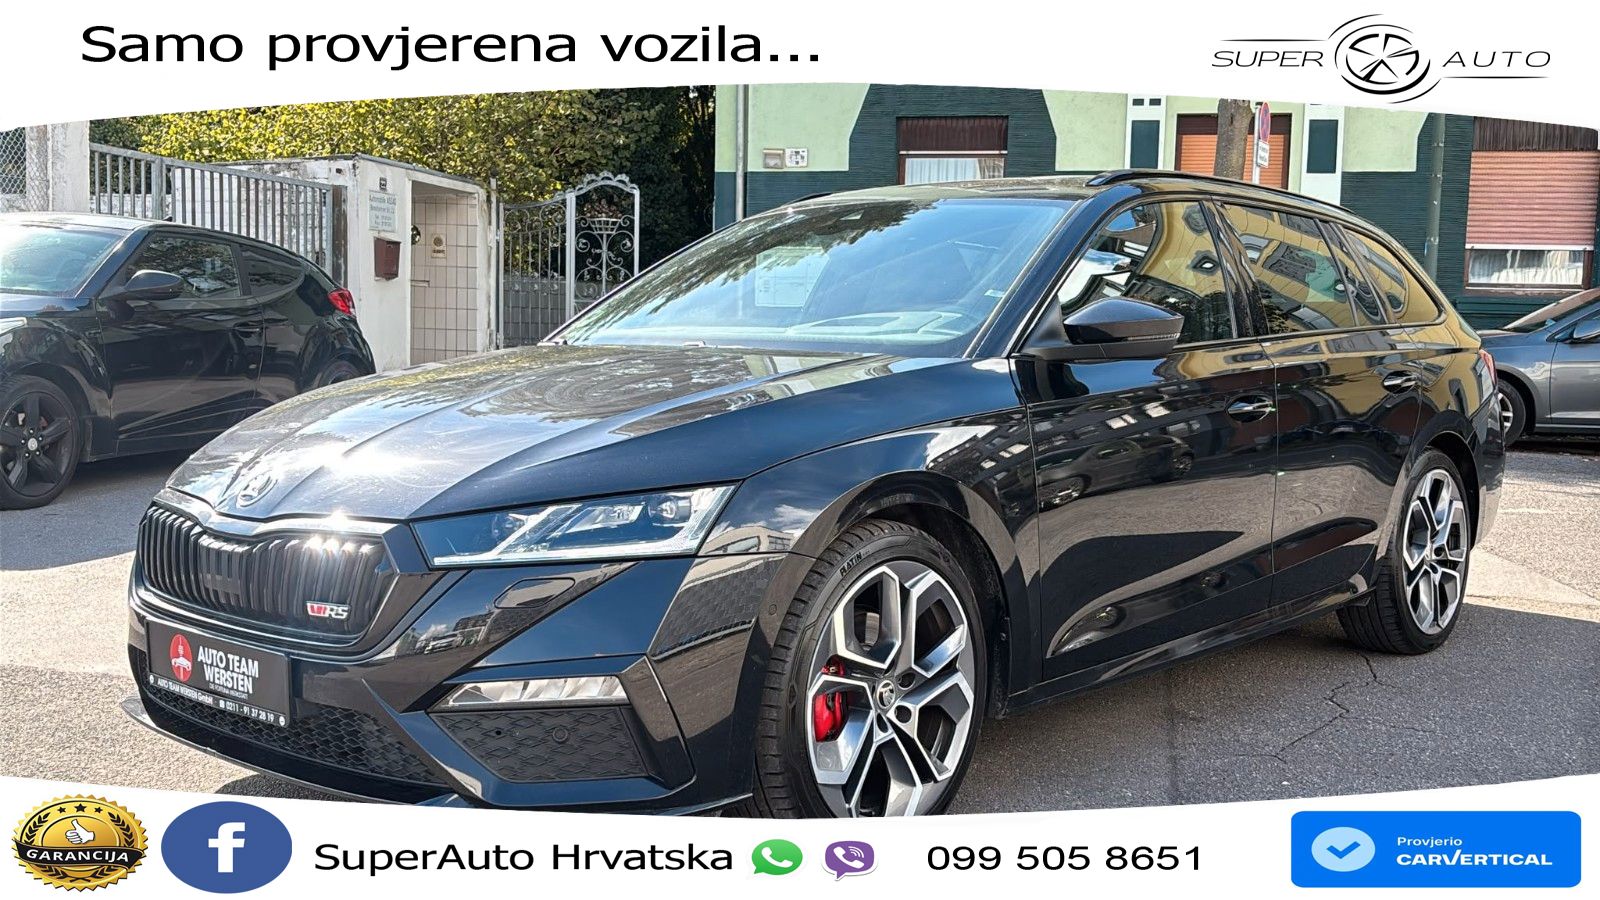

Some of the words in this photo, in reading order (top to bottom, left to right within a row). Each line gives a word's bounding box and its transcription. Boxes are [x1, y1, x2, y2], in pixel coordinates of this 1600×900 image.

[197, 645, 226, 668] AUTO
[227, 653, 259, 678] TEAM
[203, 663, 253, 694] WERSTEN
[157, 678, 168, 689] AUTO
[168, 680, 180, 692] TEAM
[179, 684, 198, 699] WERSTEN
[197, 692, 213, 705] GmbH
[225, 700, 239, 712] 0211
[251, 707, 259, 717] 37
